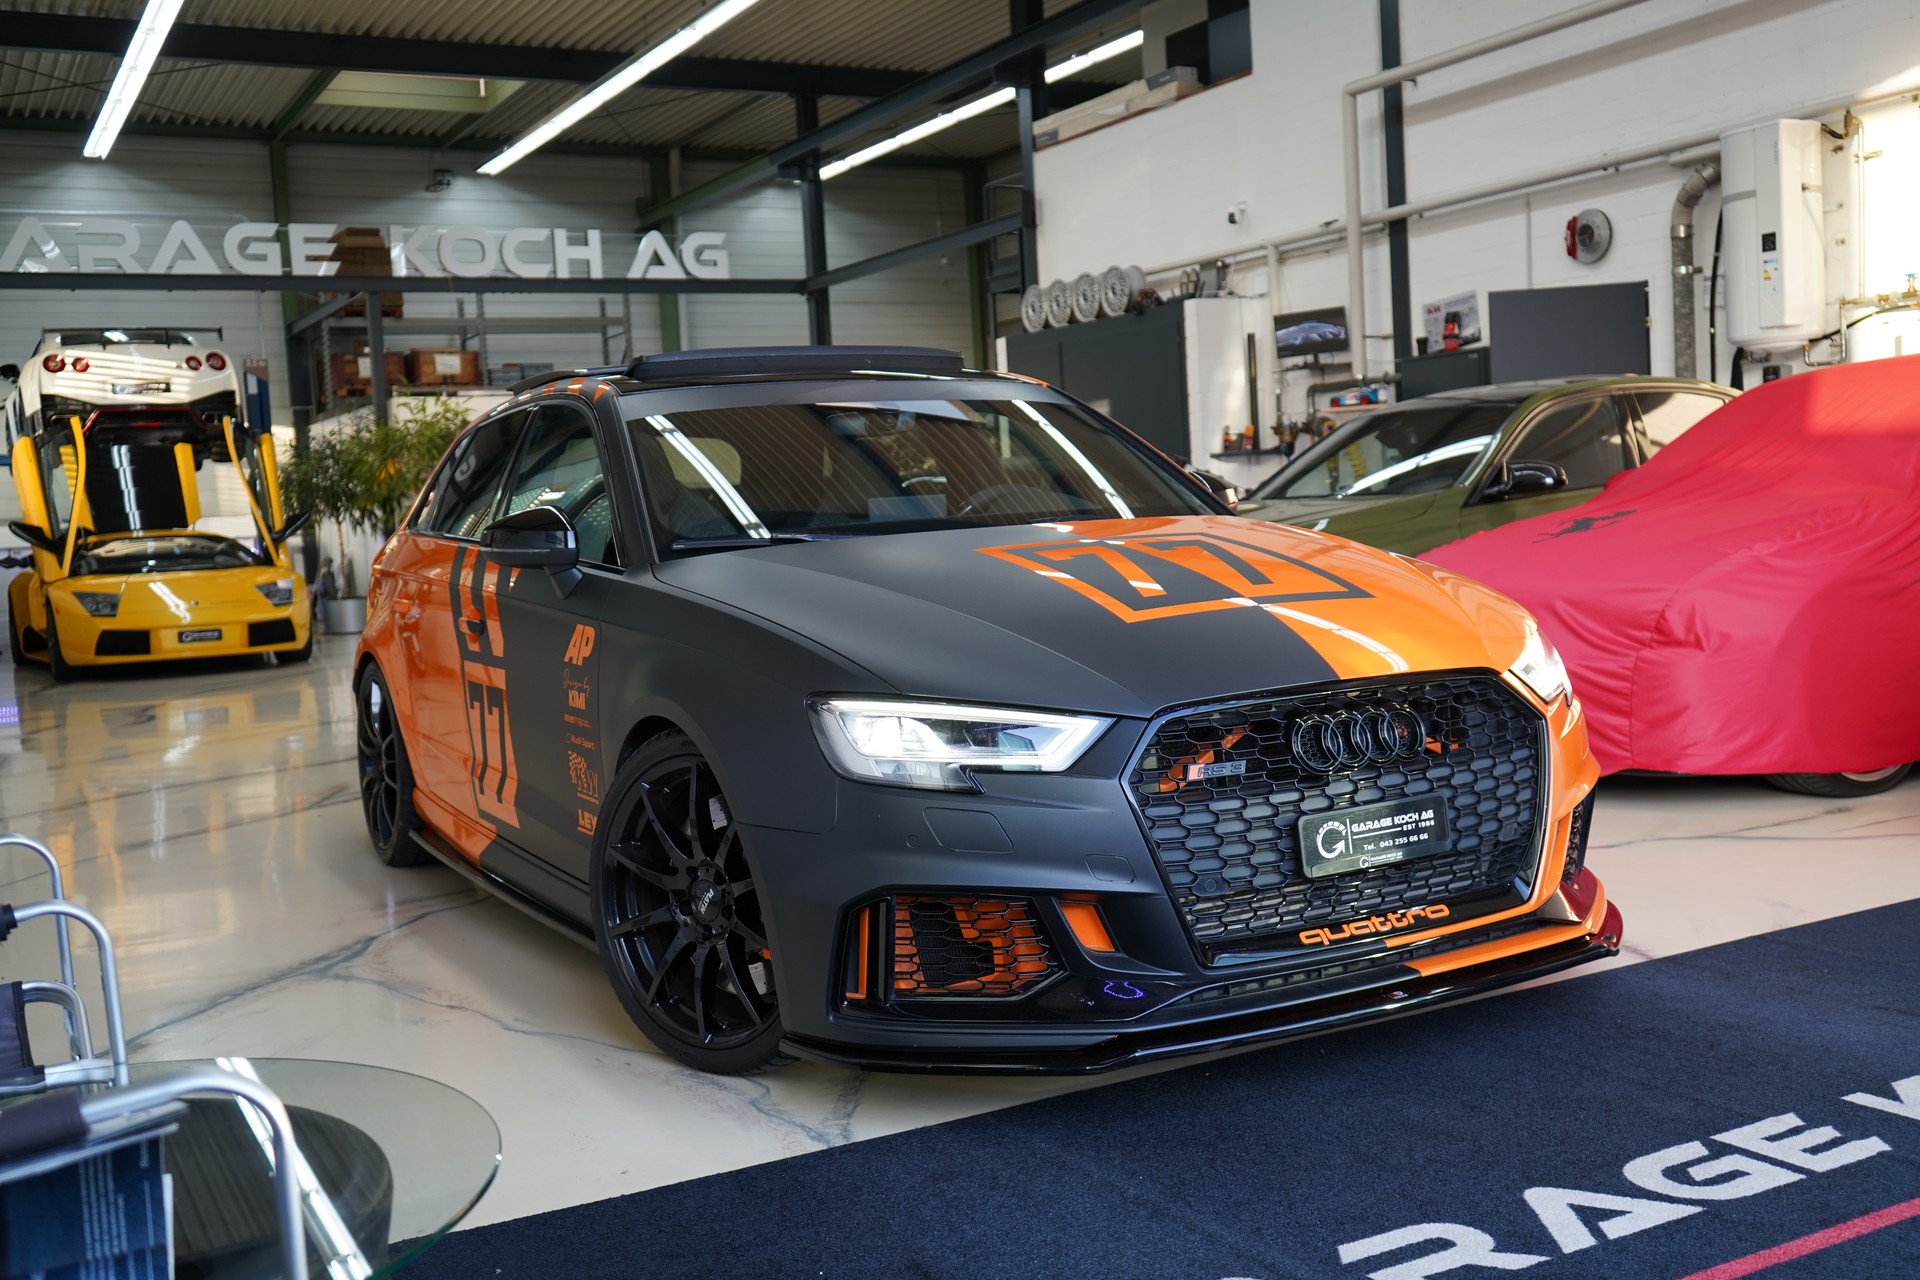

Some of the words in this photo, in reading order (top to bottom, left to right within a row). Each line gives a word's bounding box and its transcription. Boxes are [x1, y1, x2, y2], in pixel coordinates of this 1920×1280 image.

[389, 225, 603, 278] KOCH
[626, 229, 730, 279] AG
[563, 623, 596, 666] AP
[568, 689, 586, 710] KIMI
[1197, 763, 1226, 777] RS
[1230, 762, 1243, 774] 3
[1351, 817, 1393, 832] GARAGE
[1393, 812, 1419, 824] KOCH
[1420, 809, 1435, 820] AG
[1402, 822, 1416, 831] EST
[1418, 819, 1435, 828] 1986
[1363, 843, 1377, 851] Tel.
[1379, 839, 1394, 848] 043
[1394, 836, 1408, 846] 255
[1408, 834, 1419, 843] 66
[1419, 832, 1429, 841] 66
[1299, 903, 1450, 946] quattro
